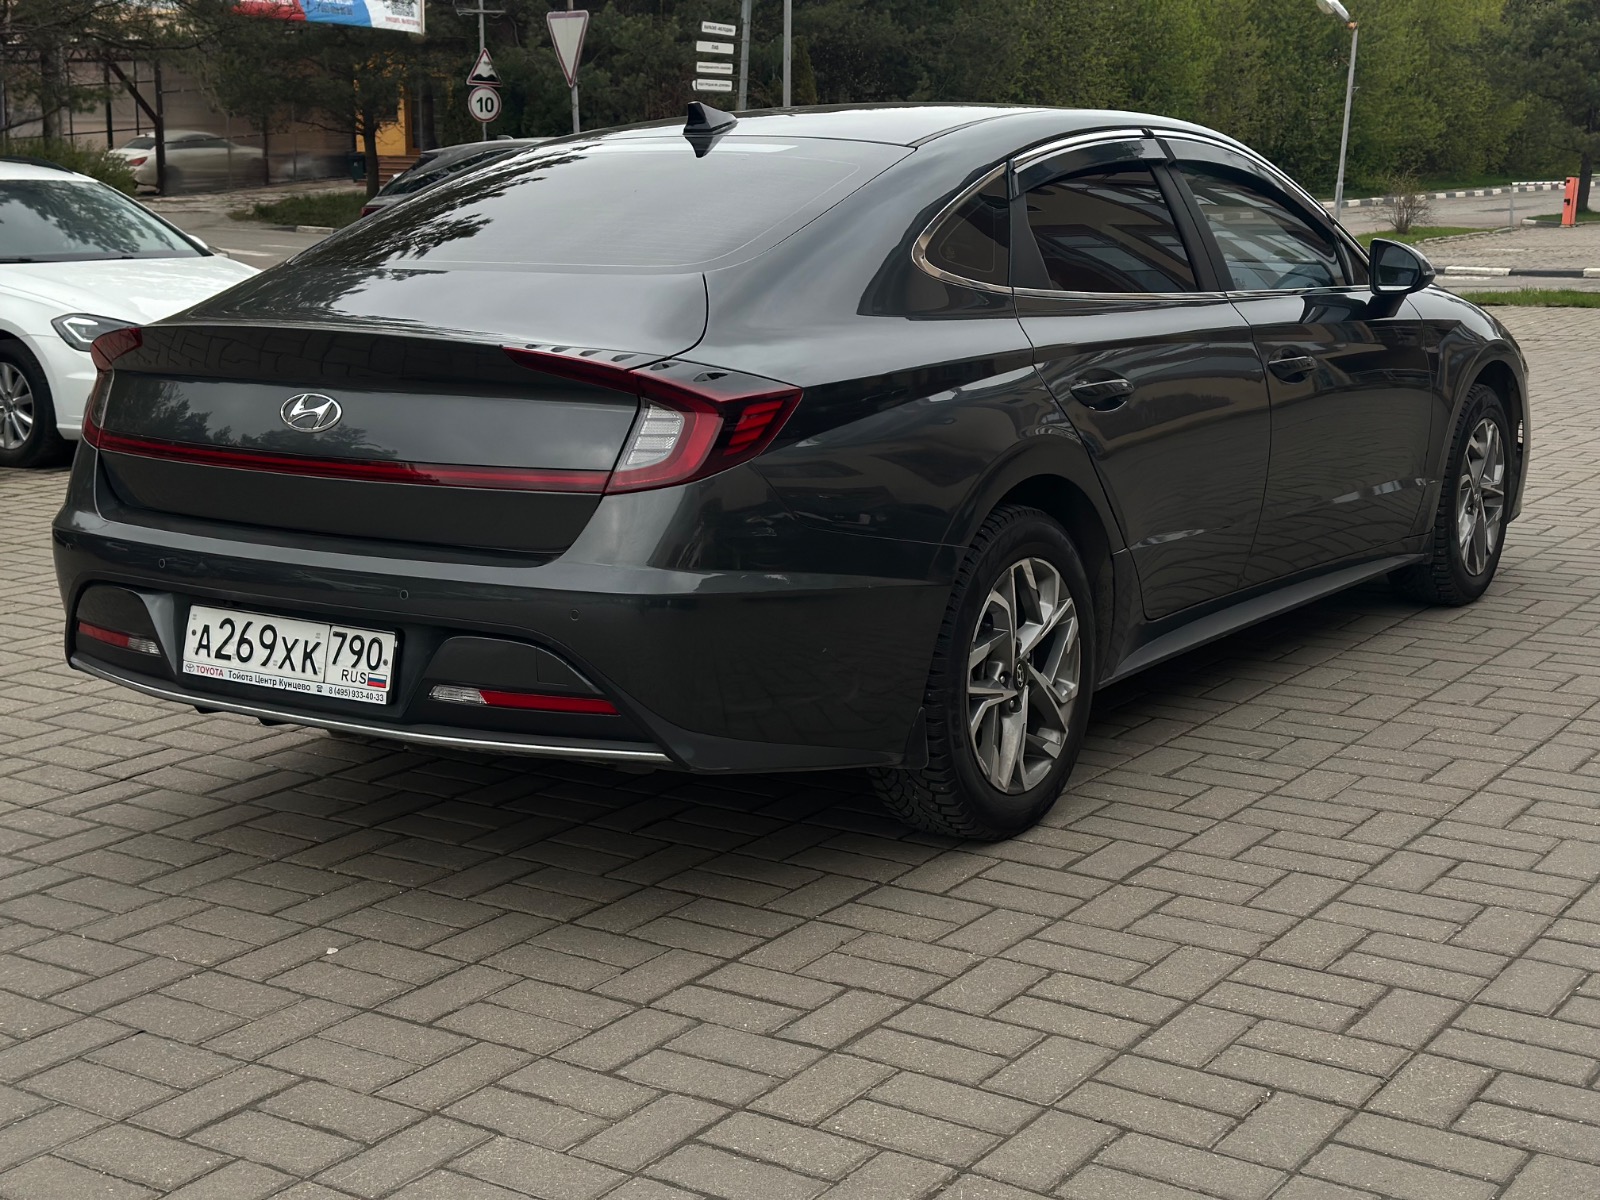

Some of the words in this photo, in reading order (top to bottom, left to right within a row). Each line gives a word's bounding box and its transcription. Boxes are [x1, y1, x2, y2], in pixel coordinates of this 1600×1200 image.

[476, 96, 494, 113] 10
[332, 631, 383, 671] 790
[196, 665, 224, 677] TOYOTA
[341, 669, 367, 684] RUS
[228, 670, 253, 682] Тойота
[254, 674, 277, 688] Центр
[279, 678, 311, 691] Кунцево
[328, 686, 333, 695] 8
[334, 686, 351, 698] (495)
[351, 690, 384, 702] 933-40-33
